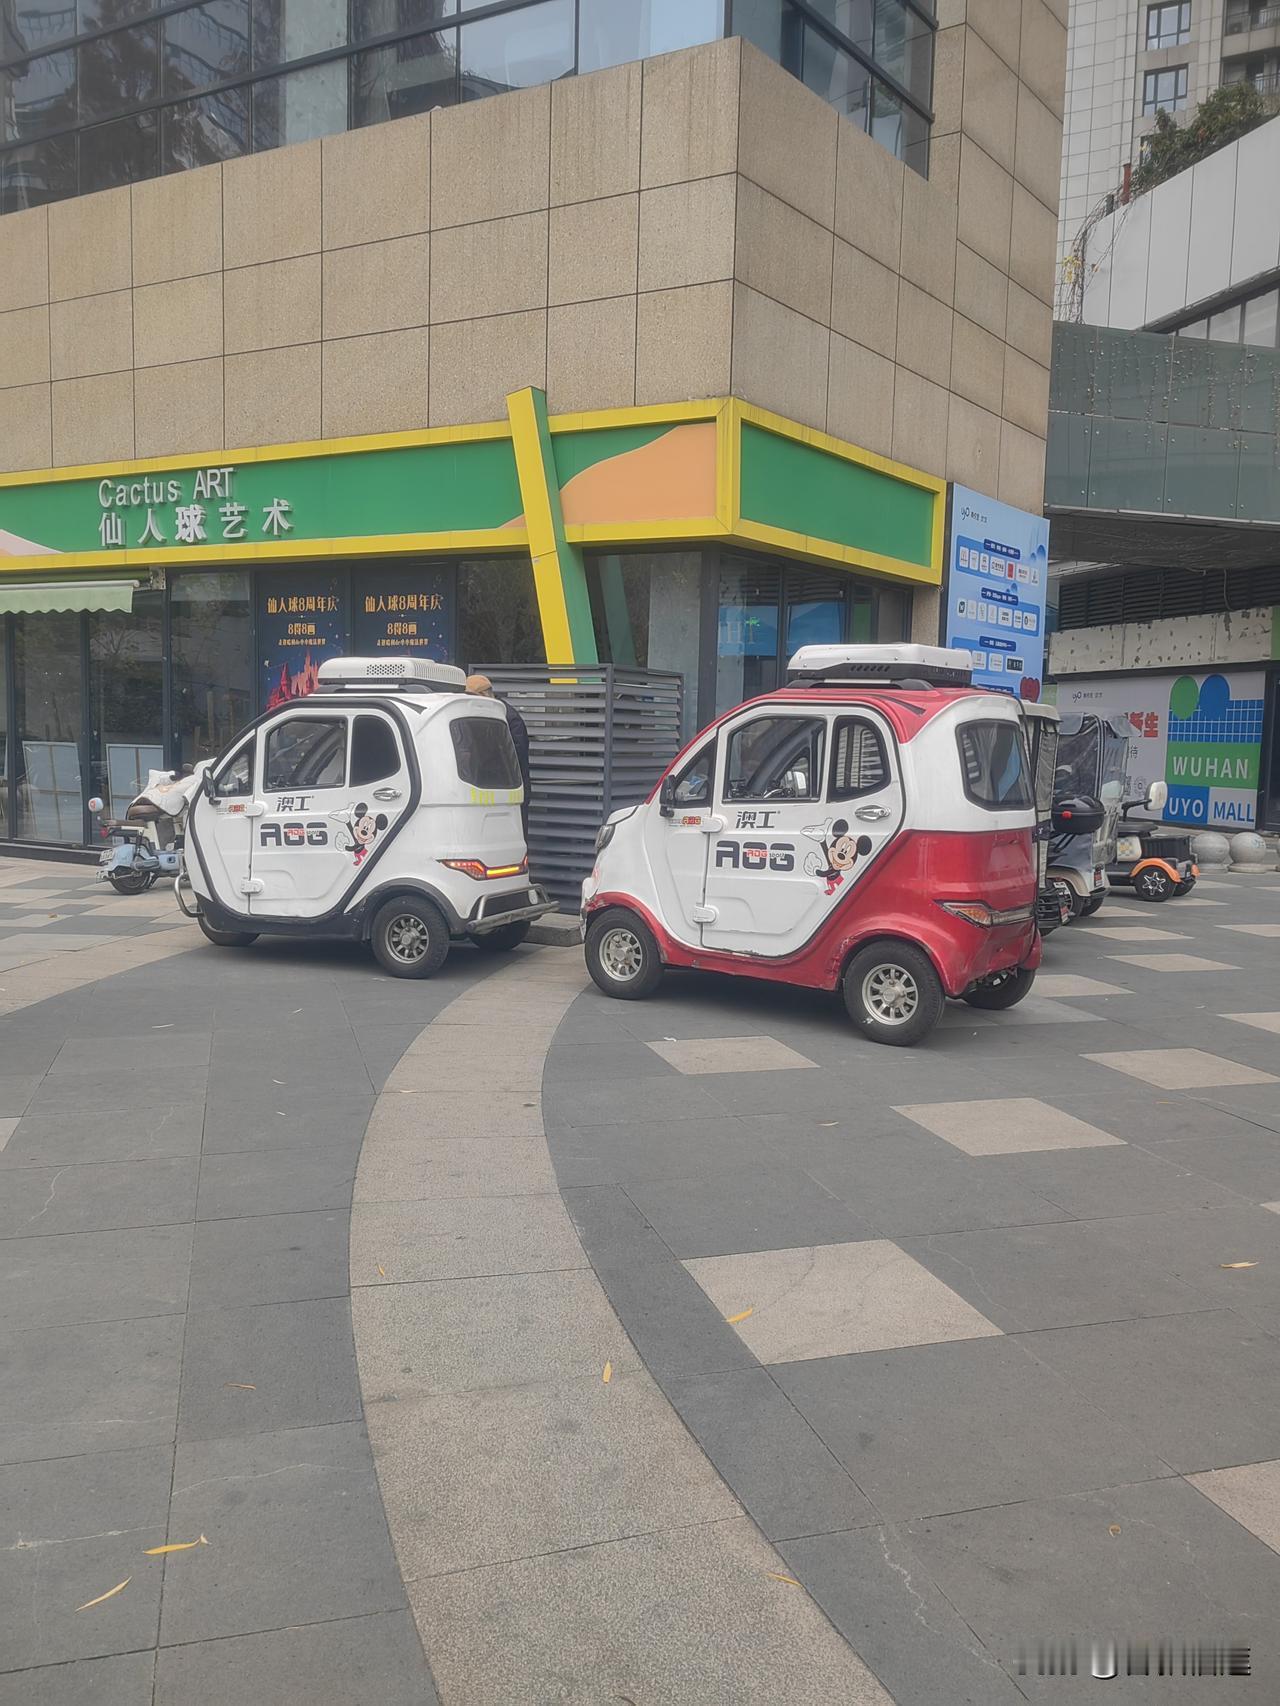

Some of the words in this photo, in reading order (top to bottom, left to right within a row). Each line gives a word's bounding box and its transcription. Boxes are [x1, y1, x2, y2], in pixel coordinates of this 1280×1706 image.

[98, 476, 181, 508] Cactus
[193, 467, 236, 500] ART
[98, 498, 294, 548] 仙人球艺术
[267, 595, 339, 614] 仙人球8周年庆
[365, 593, 442, 613] 仙人球8周年庆
[1173, 756, 1249, 779] WUHAN
[276, 796, 311, 812] 澳工
[1169, 797, 1204, 818] UYO
[1213, 801, 1255, 823] MALL
[735, 811, 776, 828] 澳工
